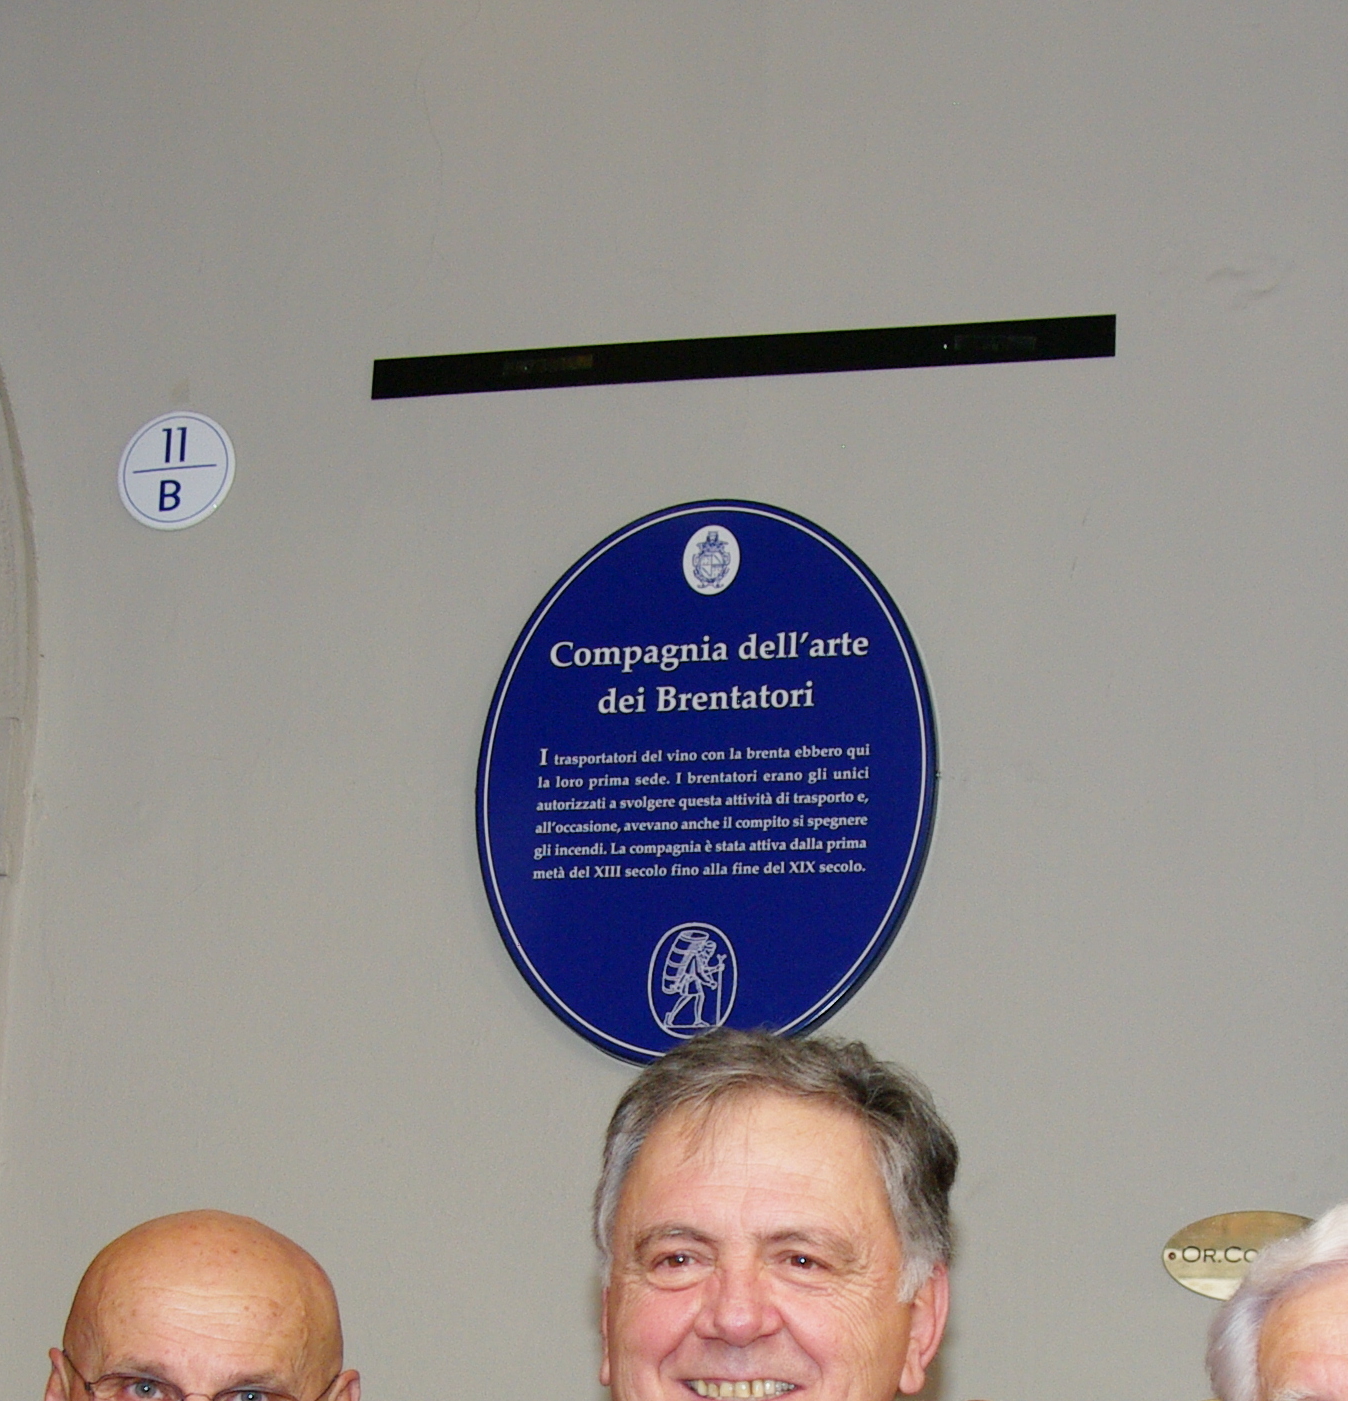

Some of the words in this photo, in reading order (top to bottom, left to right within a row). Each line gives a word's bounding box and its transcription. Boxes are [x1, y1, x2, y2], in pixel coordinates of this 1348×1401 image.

[161, 426, 187, 463] 11
[158, 479, 182, 512] B
[549, 635, 728, 673] Compagnia
[738, 631, 869, 660] dell'arte
[598, 687, 646, 714] dei
[656, 680, 814, 711] Brentatori
[539, 748, 549, 765] I
[553, 751, 638, 768] trasportatori
[640, 750, 663, 762] del
[666, 749, 698, 761] vino
[700, 751, 726, 761] con
[729, 748, 743, 760] la
[745, 747, 791, 759] brenta
[793, 745, 843, 758] ebbero
[846, 743, 871, 760] qui
[537, 776, 551, 788] la
[555, 776, 584, 788] loro
[588, 774, 630, 790] prima
[634, 773, 671, 785] sede.
[675, 772, 682, 784] I
[686, 770, 758, 784] brentatori
[762, 772, 804, 782] erano
[807, 768, 828, 784] gli
[832, 766, 870, 780] unici
[535, 797, 607, 811] autorizzati
[608, 800, 617, 809] a
[619, 796, 676, 811] svolgere
[677, 795, 723, 810] questa
[724, 792, 773, 805] attività
[775, 792, 791, 804] di
[792, 791, 855, 807] trasporto
[856, 793, 870, 804] e,
[534, 820, 622, 834] all'occasione,
[623, 821, 679, 831] avevano
[680, 817, 721, 830] anche
[722, 816, 733, 829] il
[734, 815, 791, 831] compito
[792, 815, 805, 827] si
[806, 816, 869, 830] spegnere
[532, 844, 552, 860] gli
[554, 843, 608, 856] incendi.
[610, 843, 627, 854] La
[628, 840, 702, 857] compagnia
[704, 840, 713, 852] è
[714, 840, 747, 852] stata
[748, 838, 787, 851] attiva
[789, 837, 824, 850] dalla
[825, 837, 867, 853] prima
[532, 866, 566, 879] metà
[568, 866, 591, 878] del
[593, 865, 622, 878] XIII
[624, 864, 668, 877] secolo
[670, 864, 700, 876] fino
[702, 863, 729, 875] alla
[731, 862, 760, 875] fine
[762, 861, 786, 874] del
[788, 861, 816, 873] XIX
[818, 860, 867, 873] secolo.
